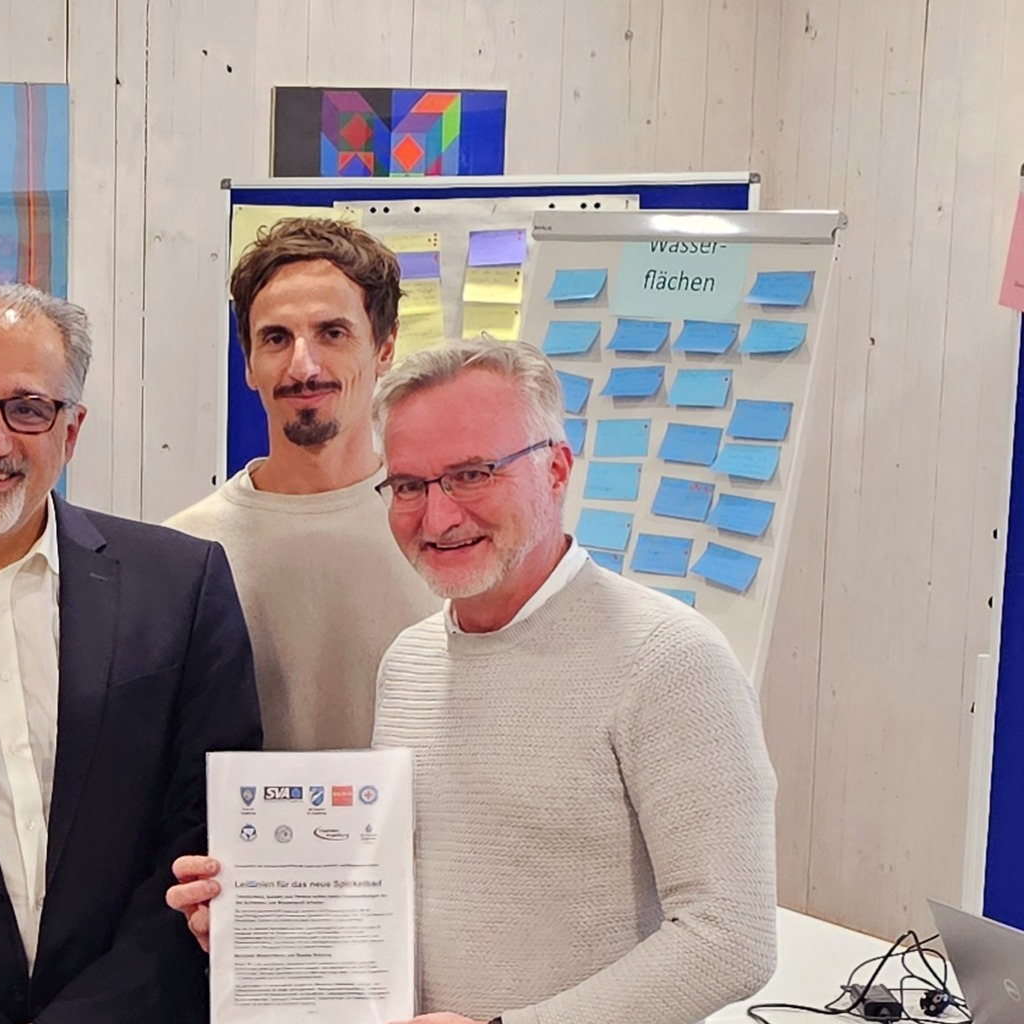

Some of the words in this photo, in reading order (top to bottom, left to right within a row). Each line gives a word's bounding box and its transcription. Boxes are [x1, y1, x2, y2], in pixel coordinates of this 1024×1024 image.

[650, 241, 727, 254] Wasser-
[643, 269, 715, 292] flächen
[266, 787, 290, 799] SVA
[276, 879, 289, 888] für
[291, 879, 307, 888] das
